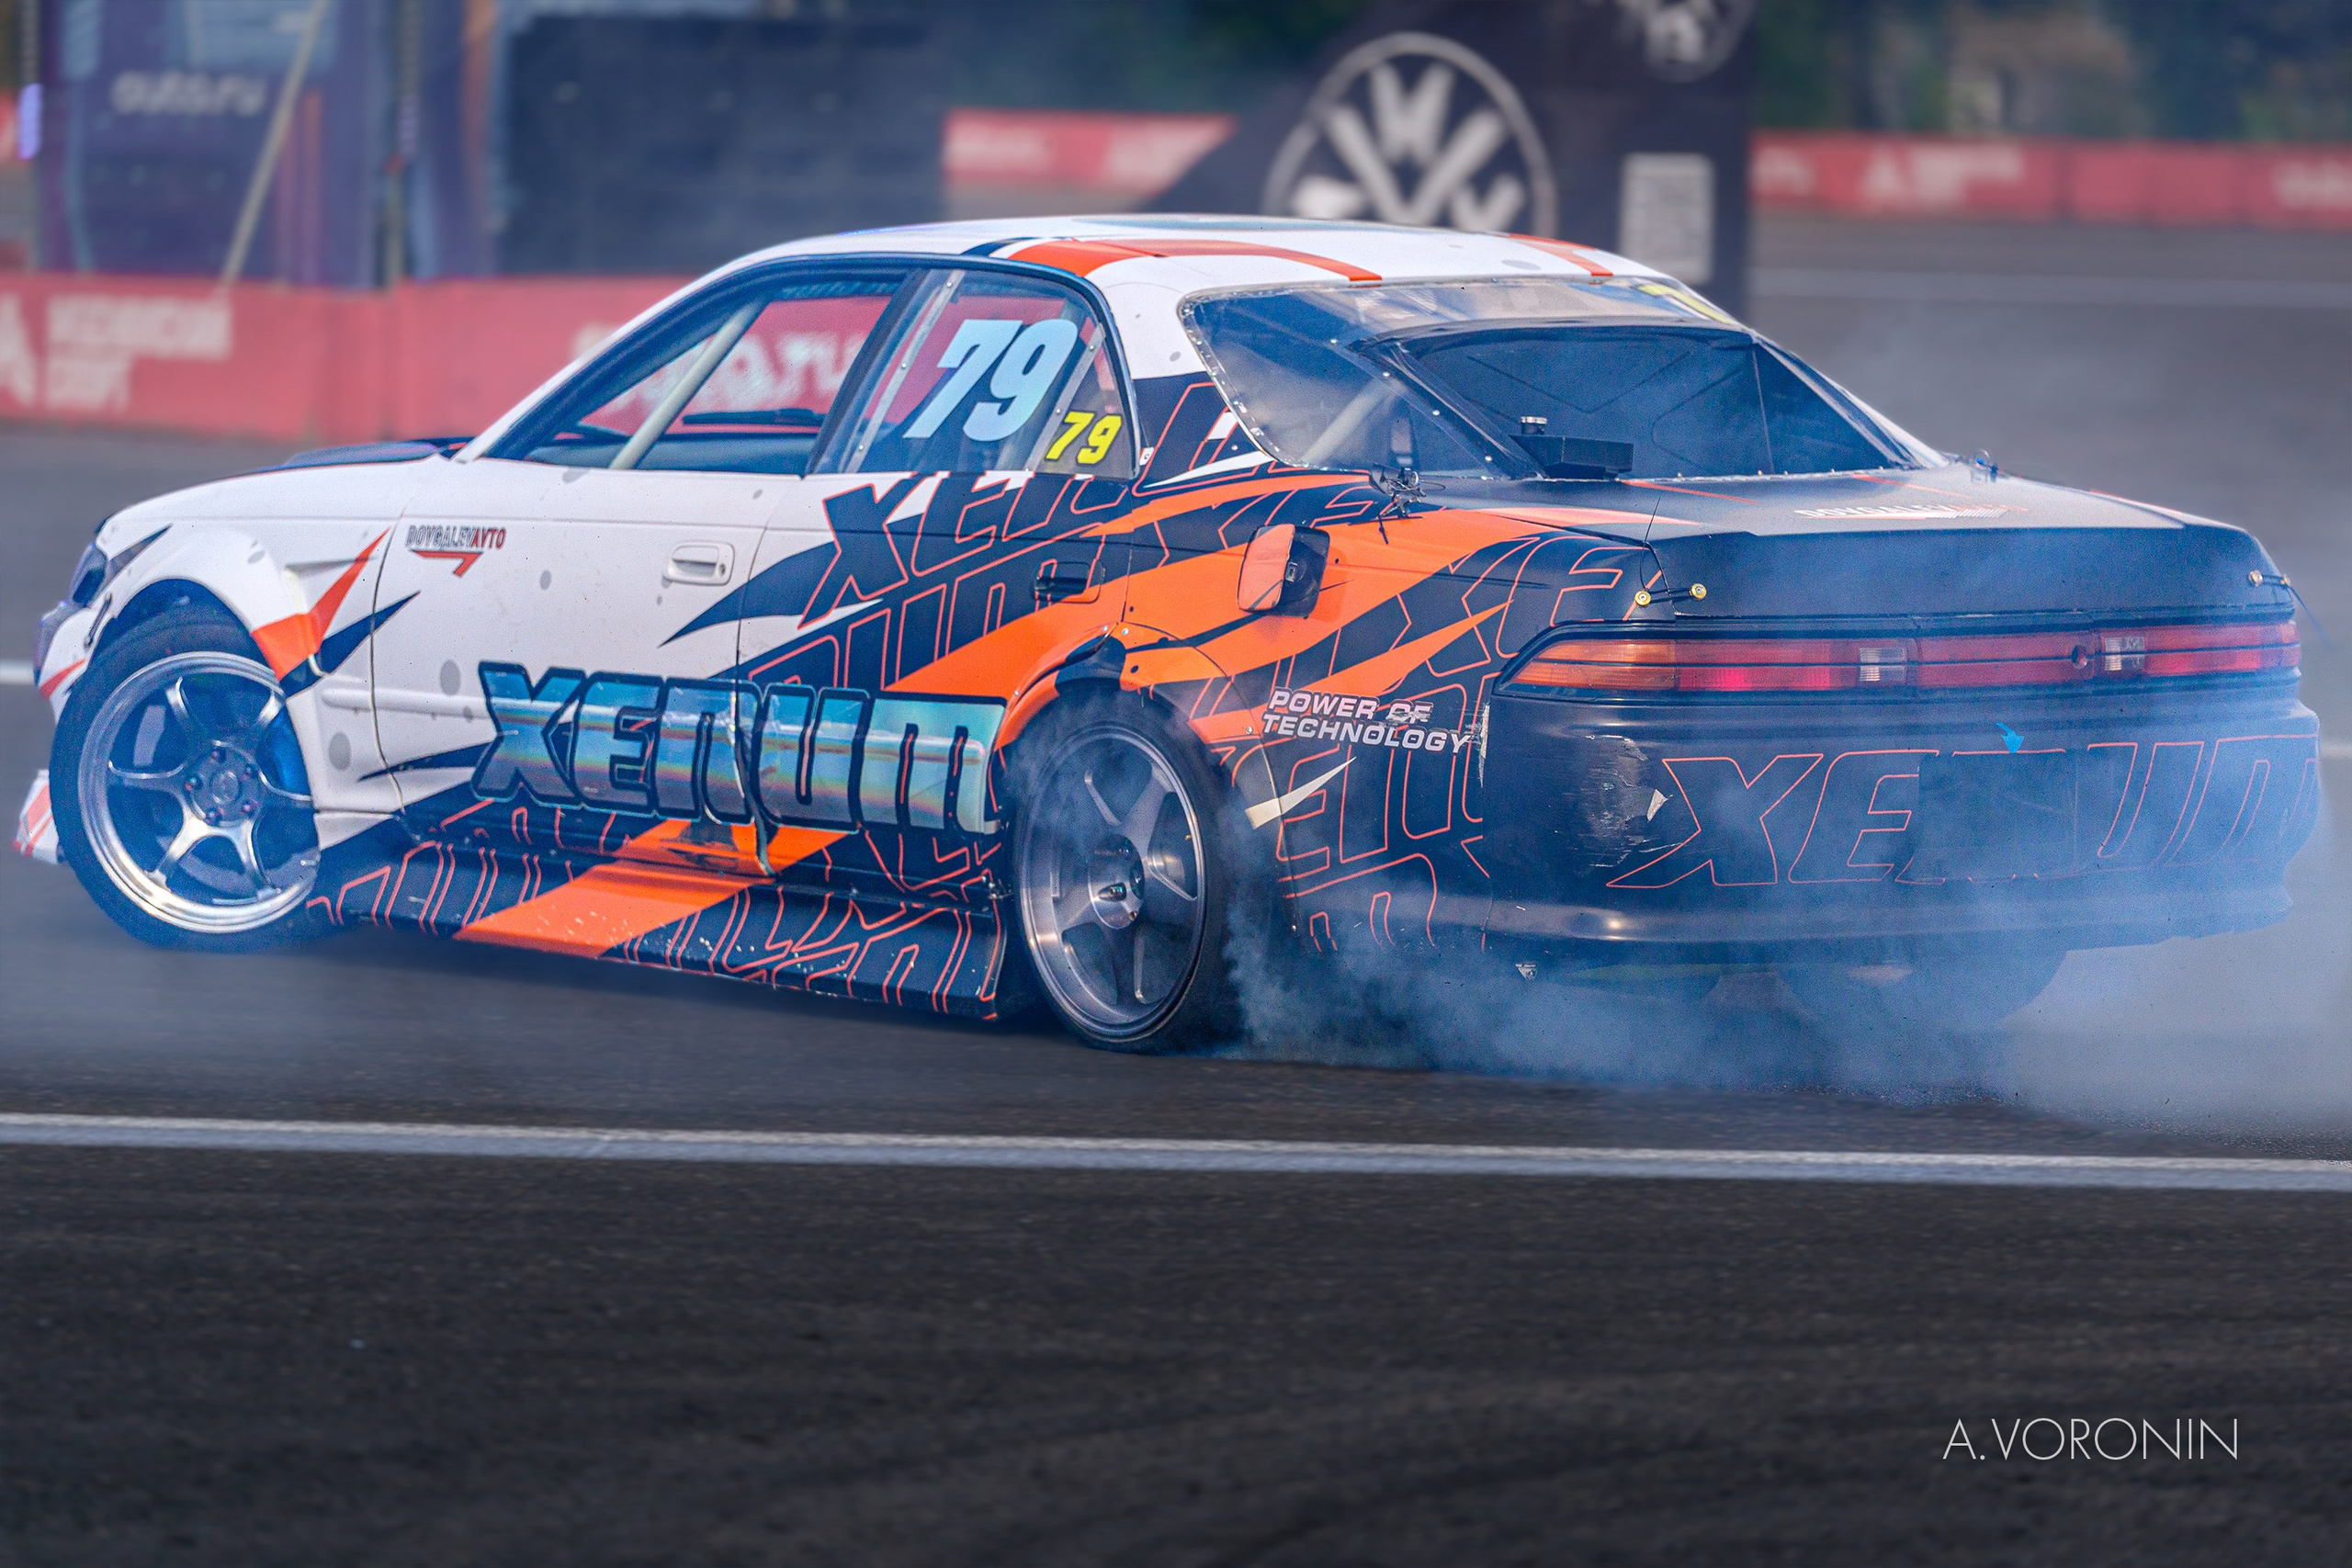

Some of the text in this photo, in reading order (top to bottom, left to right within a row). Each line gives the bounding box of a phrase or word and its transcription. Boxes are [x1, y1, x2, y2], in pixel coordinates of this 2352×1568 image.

[902, 319, 1088, 442] 79
[1046, 412, 1122, 465] 79
[1265, 688, 1434, 727] POWER OF
[1261, 712, 1472, 754] TECHNOLOGY
